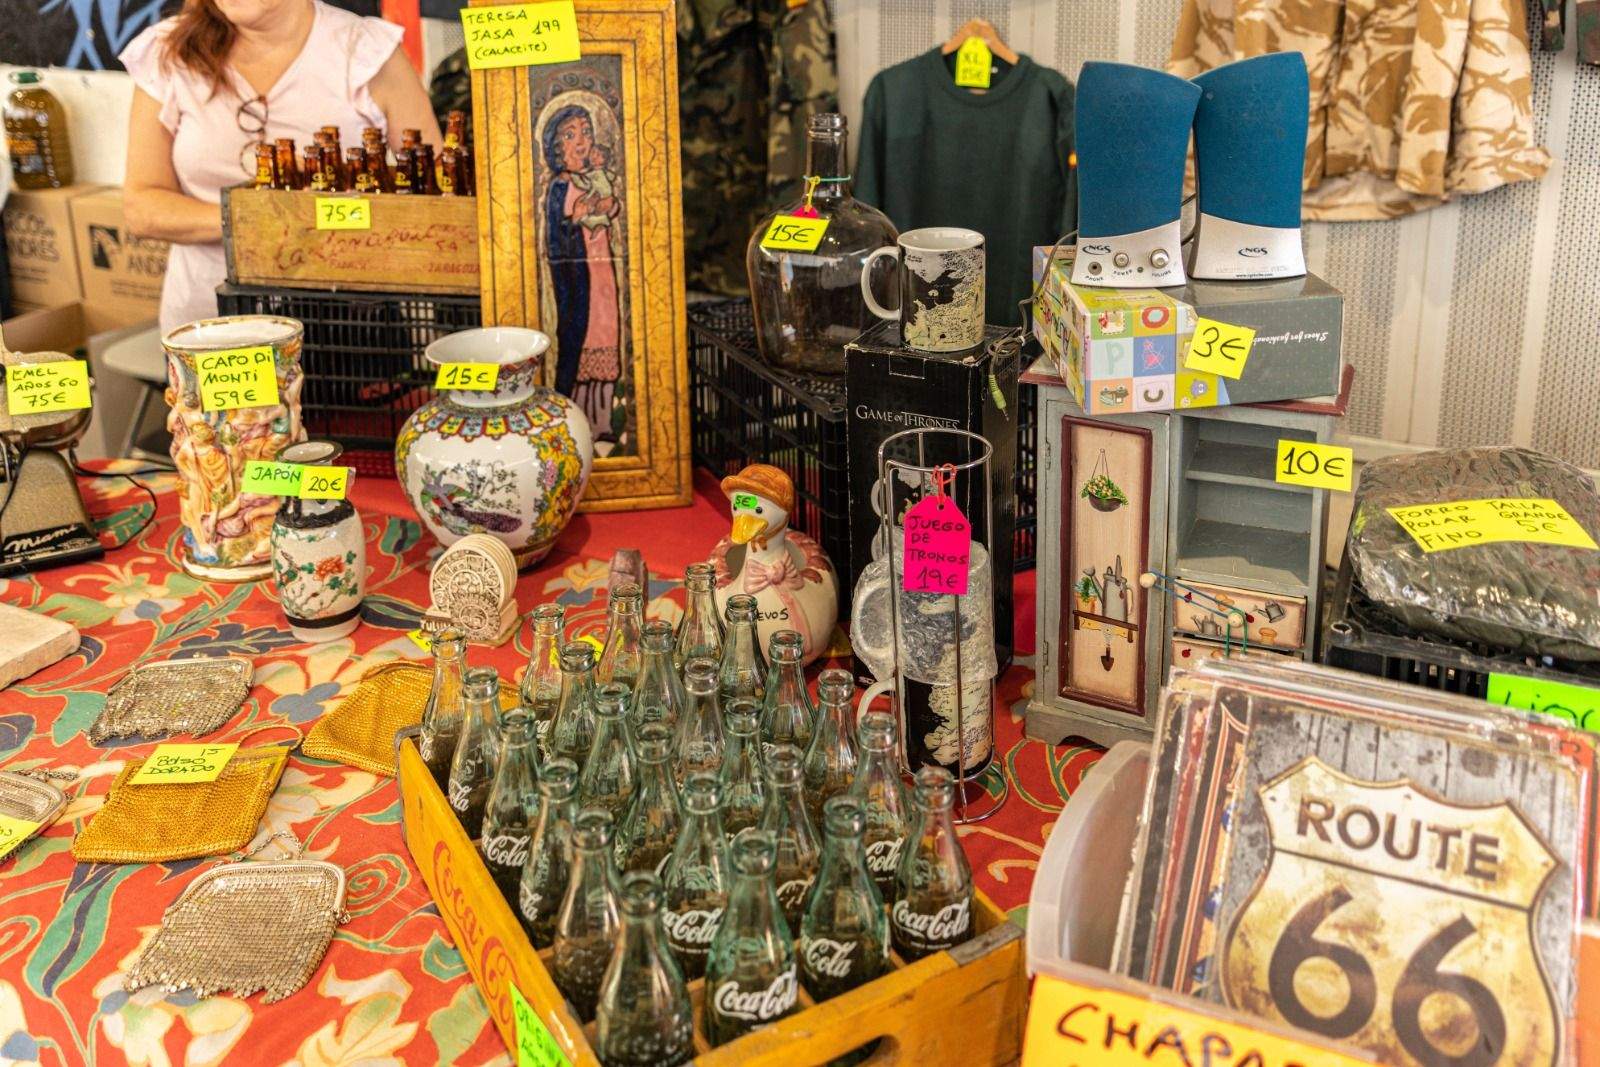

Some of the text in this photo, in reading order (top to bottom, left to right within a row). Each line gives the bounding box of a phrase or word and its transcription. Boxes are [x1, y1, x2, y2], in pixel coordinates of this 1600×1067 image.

[466, 9, 528, 24] TERESA
[472, 19, 561, 41] JASA 199
[321, 204, 364, 222] 75€
[769, 222, 817, 244] 15€
[1084, 244, 1112, 255] NGS
[1240, 247, 1268, 257] NGS
[1193, 326, 1246, 361] 3€
[1305, 331, 1329, 342] Shoes
[202, 354, 249, 370] CAPO
[58, 377, 79, 388] 60
[444, 366, 490, 386] 15€
[22, 391, 67, 408] 75€
[213, 389, 257, 407] 59€
[855, 404, 893, 422] GAME
[901, 411, 960, 431] THRONES
[1281, 446, 1346, 478] 10€
[251, 464, 302, 482] JAPÓN
[307, 475, 343, 493] 20€
[1394, 504, 1470, 522] FORRO
[1486, 500, 1545, 511] TALLA
[908, 515, 965, 532] JUEGO
[1405, 514, 1477, 533] POLAR
[1499, 511, 1570, 521] GRANDE
[1515, 519, 1563, 535] 5€
[910, 532, 931, 545] DE
[1419, 530, 1484, 549] FINO
[906, 548, 969, 566] TRONOS
[916, 566, 959, 590] 19€
[1297, 793, 1500, 882] ROUTE
[1269, 886, 1507, 1067] 66
